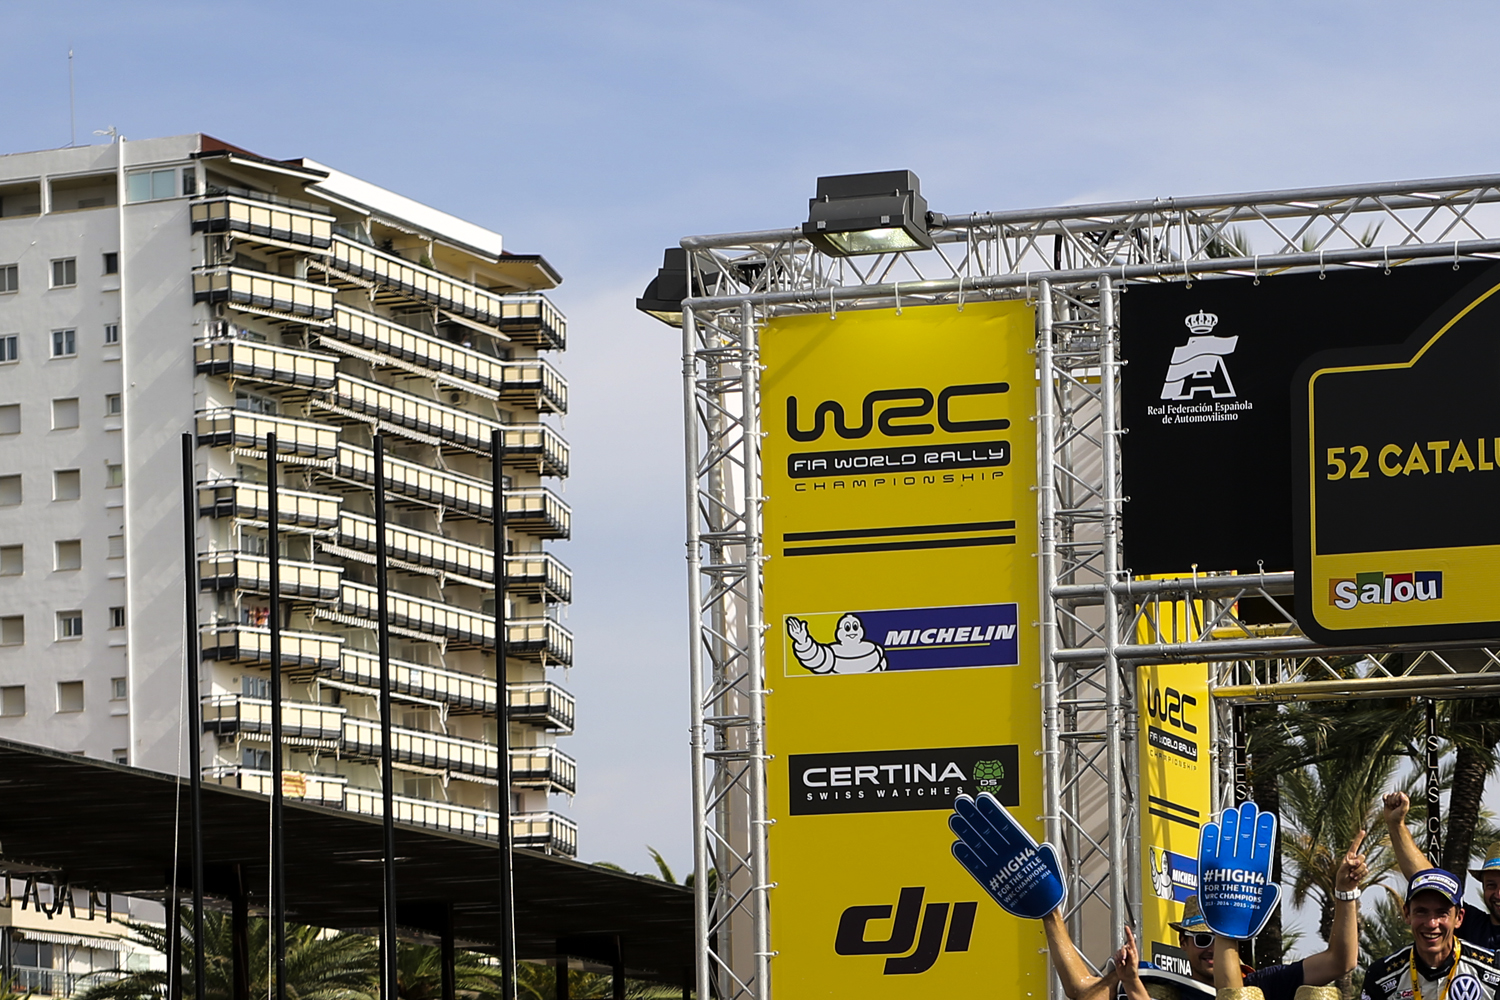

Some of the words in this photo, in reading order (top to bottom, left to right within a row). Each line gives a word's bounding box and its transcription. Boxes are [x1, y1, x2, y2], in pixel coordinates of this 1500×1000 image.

[786, 382, 1010, 442] WRC
[1147, 405, 1167, 417] Real
[1162, 414, 1173, 425] de
[794, 458, 827, 471] FIA
[835, 453, 917, 469] WORLD
[924, 447, 1004, 465] RALLY
[1326, 445, 1370, 481] 52
[794, 471, 1004, 492] CHAMPIONSHIP
[884, 624, 1016, 646] MICHELIN
[802, 762, 968, 788] CERTINA
[806, 791, 864, 801] SWISS
[877, 786, 964, 799] WATCHES
